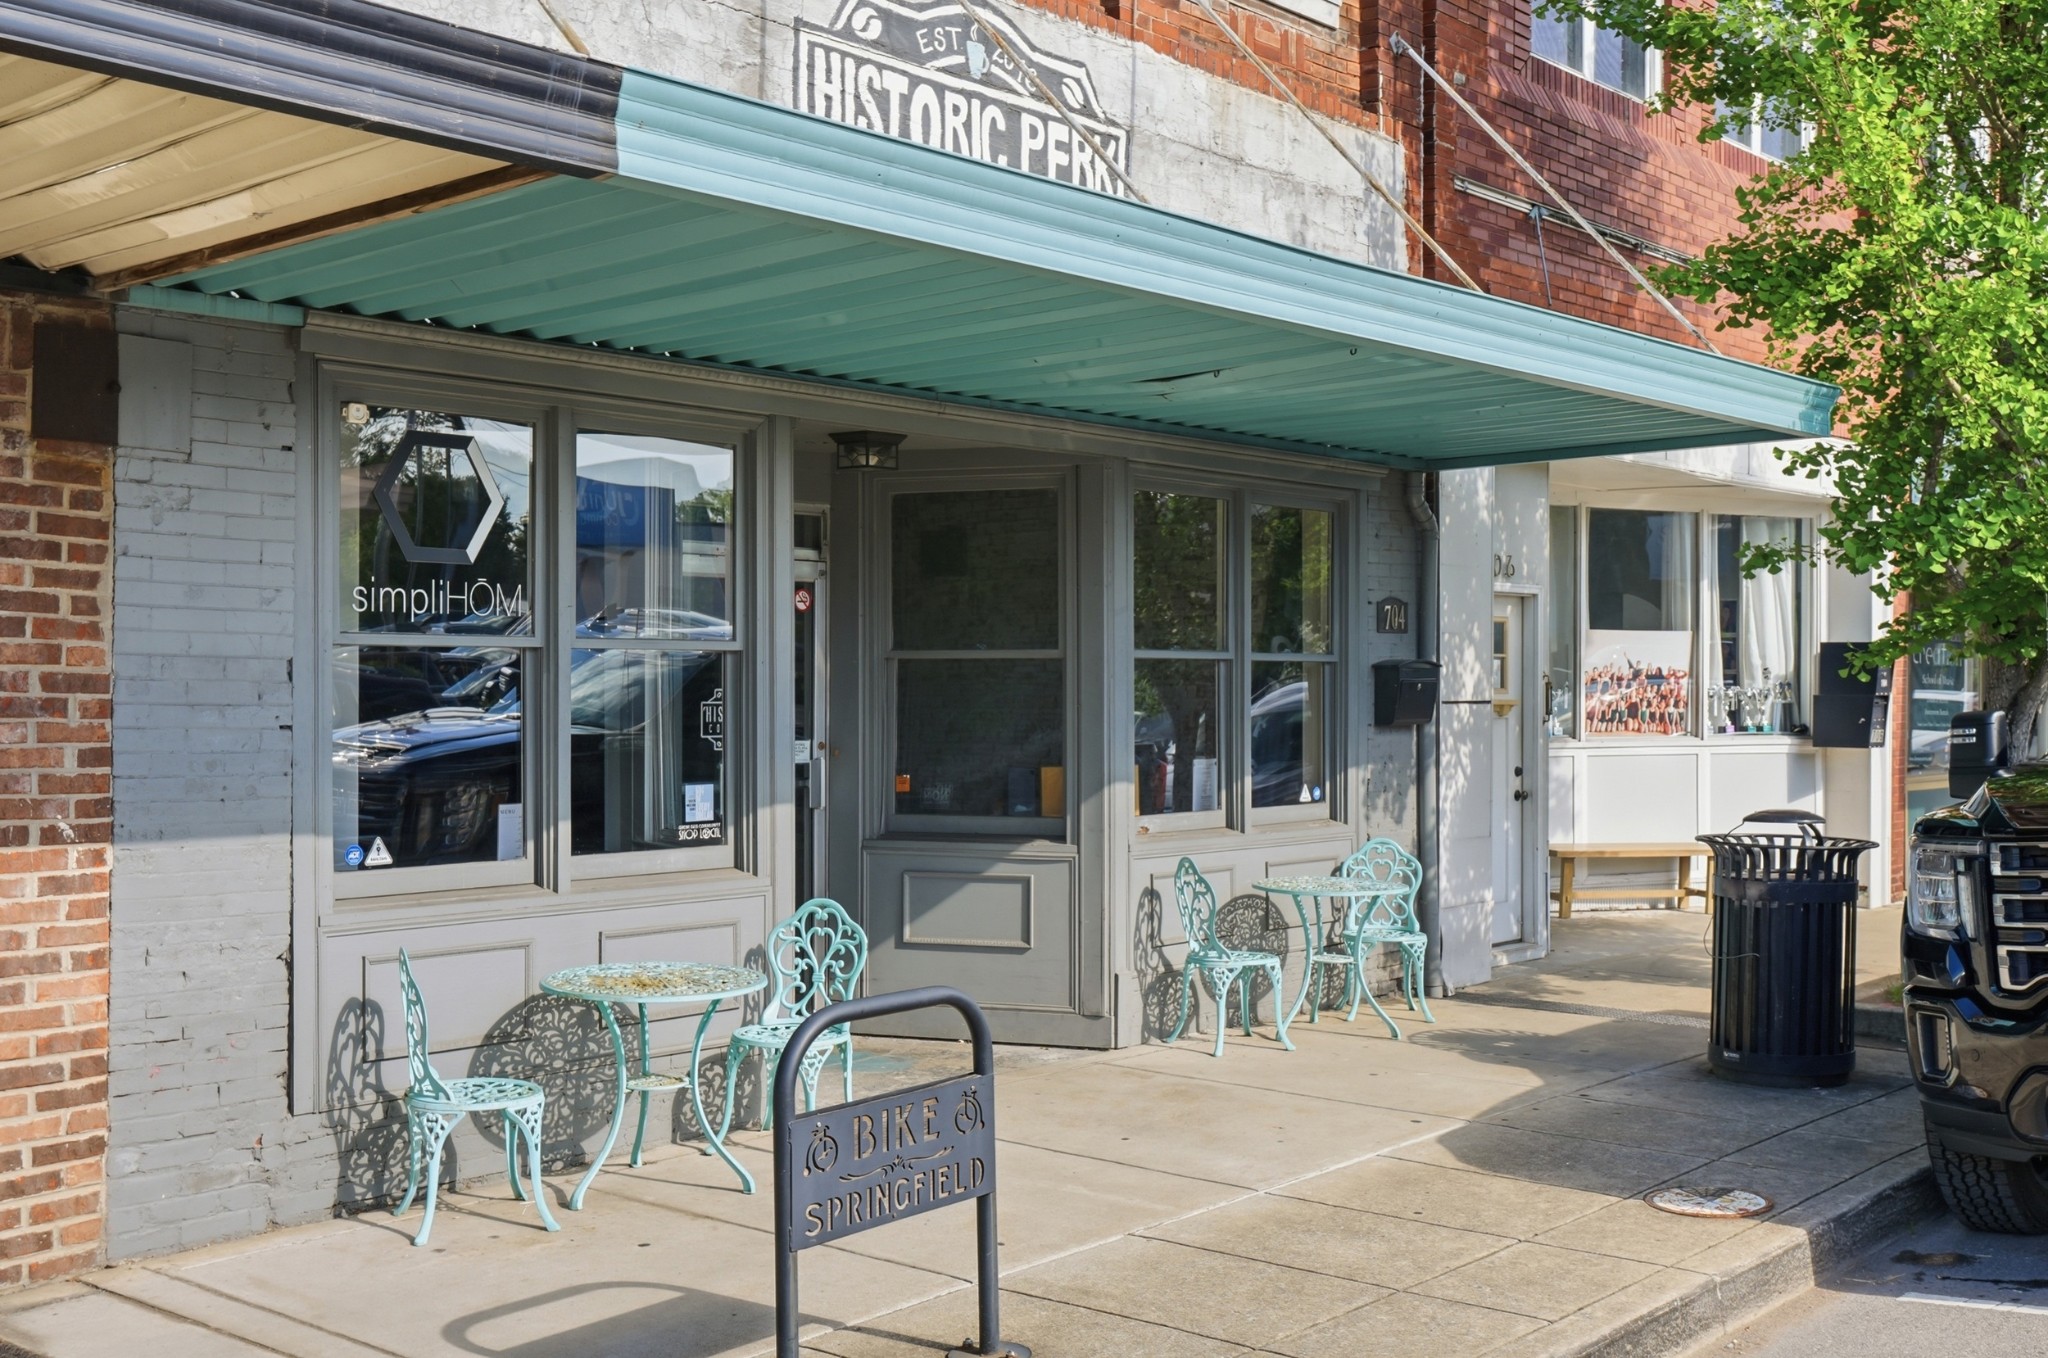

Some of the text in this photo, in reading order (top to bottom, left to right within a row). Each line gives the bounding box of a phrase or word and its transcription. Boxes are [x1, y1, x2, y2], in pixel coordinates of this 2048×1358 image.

[915, 26, 964, 54] EST.
[814, 46, 1006, 168] HISTORIC
[1383, 604, 1406, 631] 704
[678, 828, 698, 841] SHOP
[853, 1096, 941, 1161] BIKE
[804, 1157, 985, 1237] SPRINGFIELD
